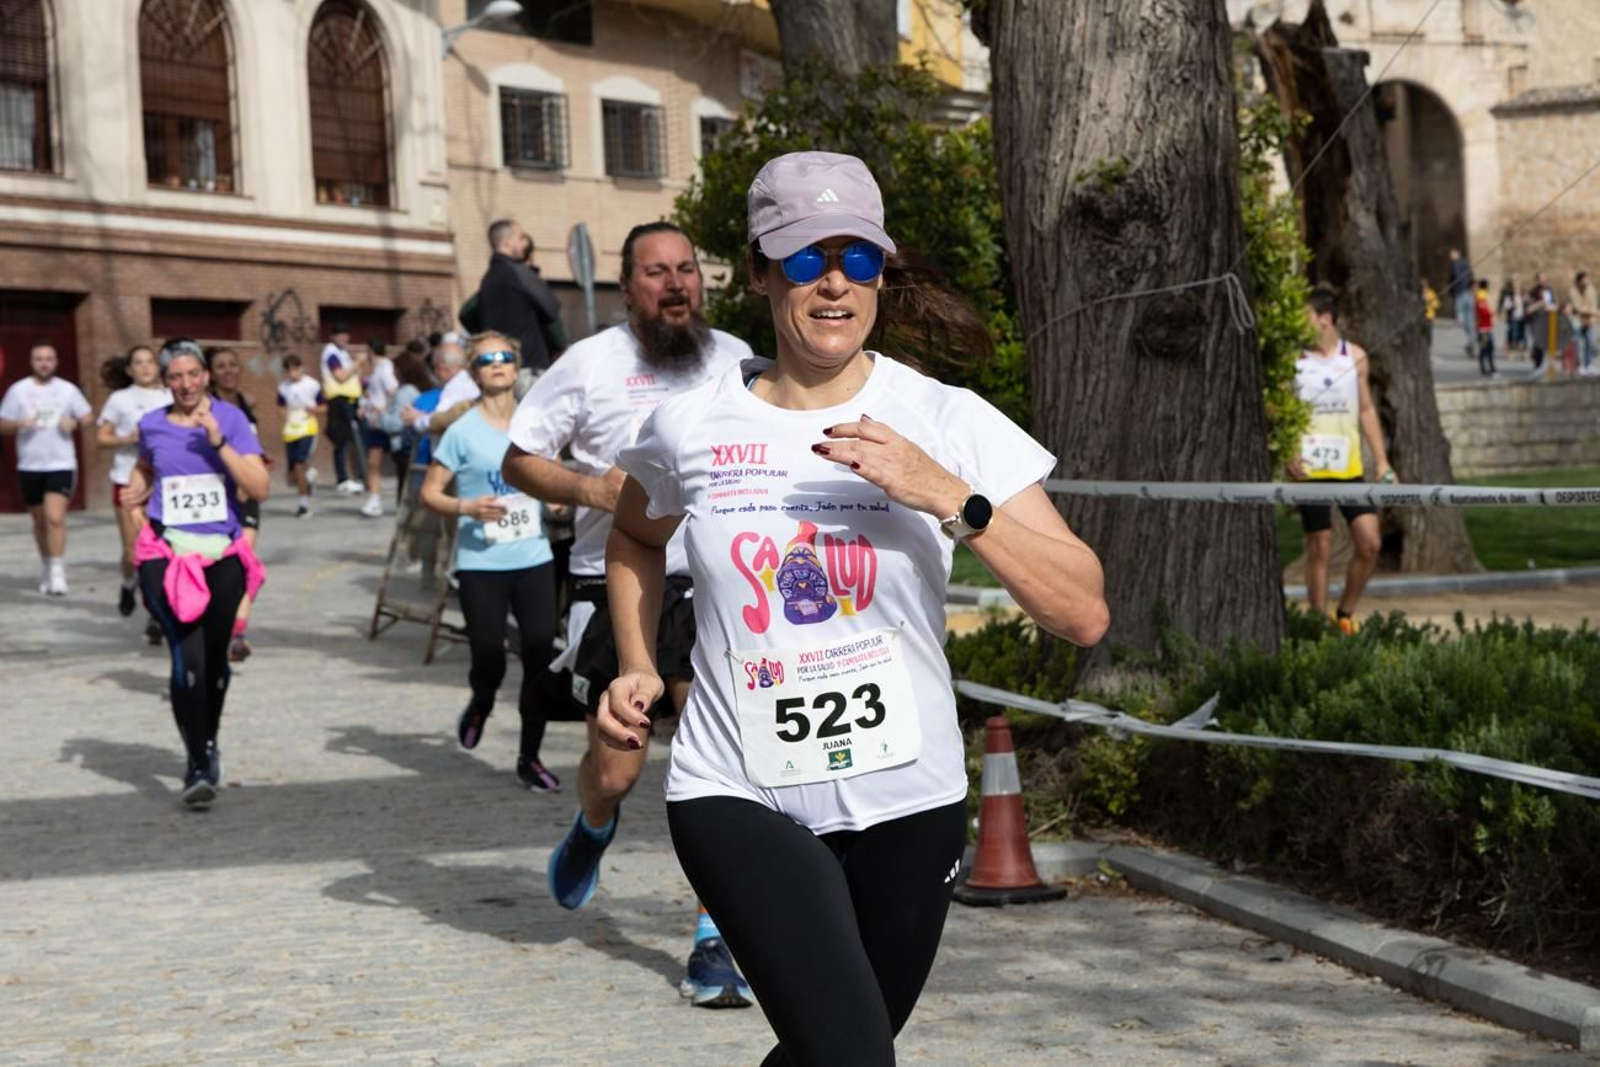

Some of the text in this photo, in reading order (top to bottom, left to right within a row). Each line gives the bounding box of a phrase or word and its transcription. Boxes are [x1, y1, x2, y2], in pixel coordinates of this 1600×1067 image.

[710, 443, 768, 466] XXVII
[1312, 447, 1341, 461] 473
[745, 468, 788, 478] POPULAR
[171, 490, 221, 511] 1233
[738, 502, 757, 512] cada
[798, 649, 824, 664] XXVII
[824, 643, 855, 660] CARRERA
[797, 665, 809, 674] POR
[775, 682, 887, 743] 523
[822, 737, 853, 751] JUANA
